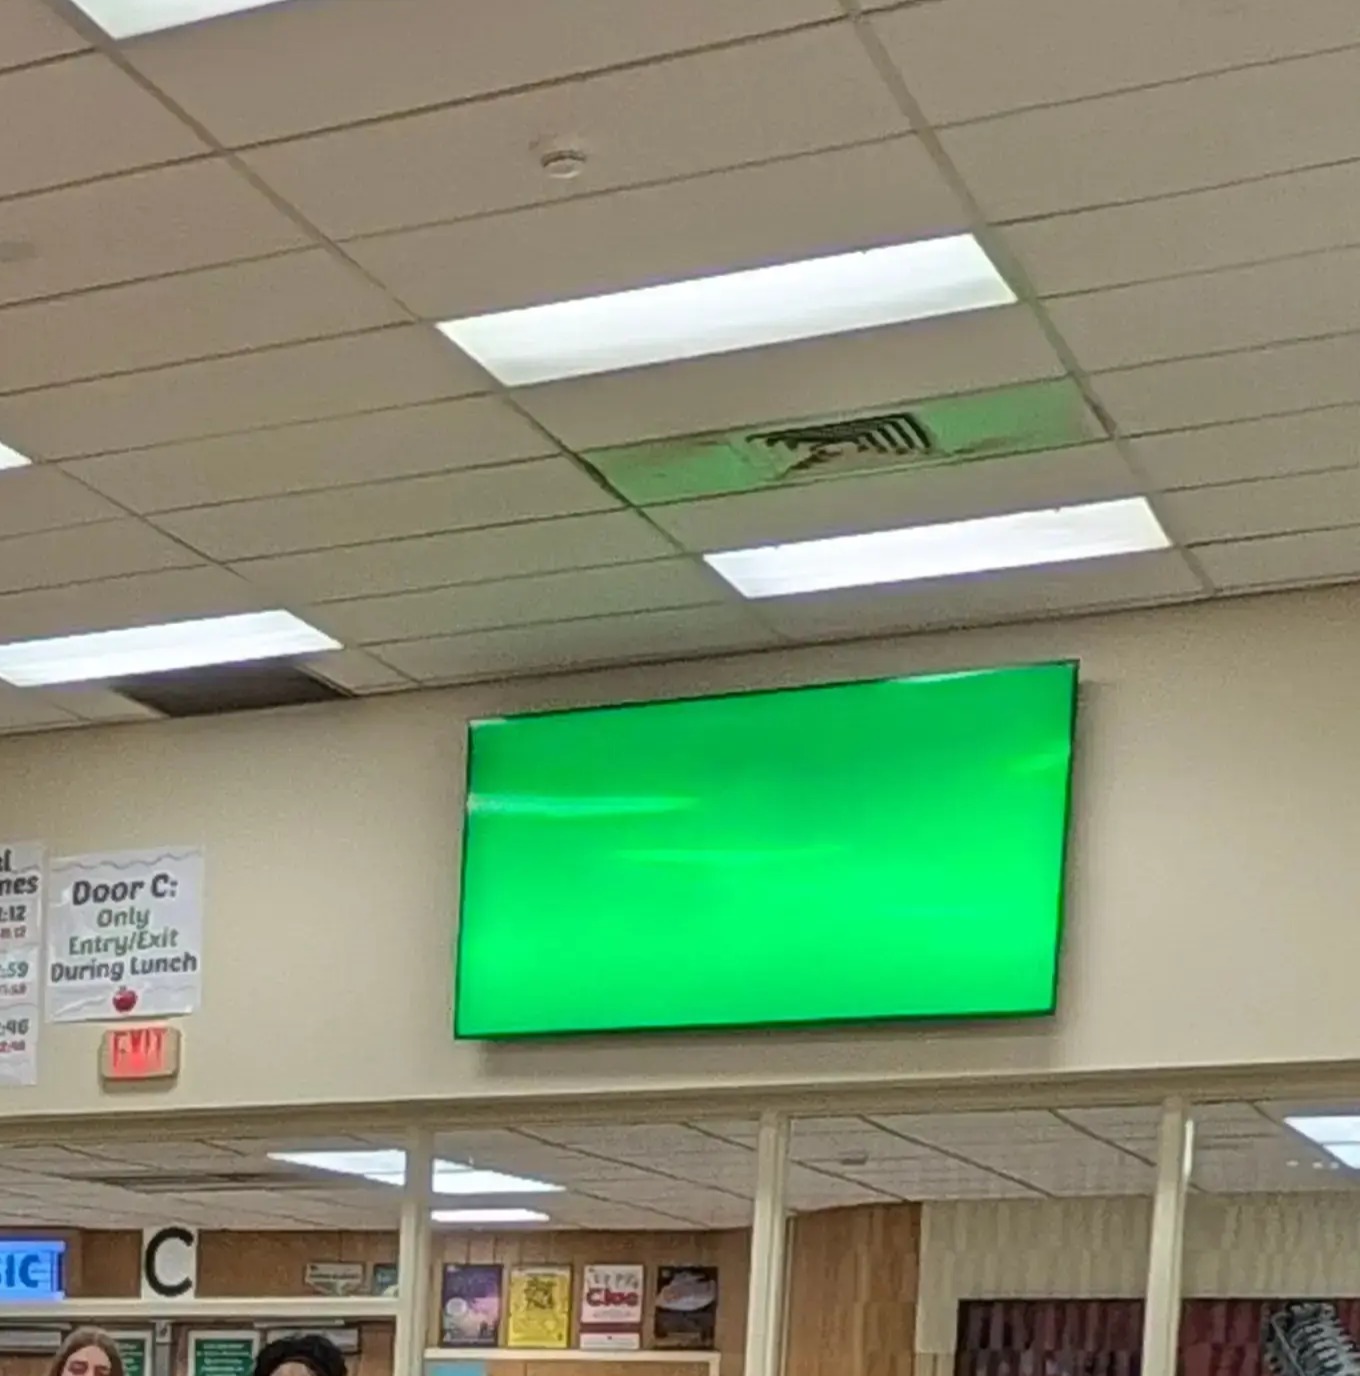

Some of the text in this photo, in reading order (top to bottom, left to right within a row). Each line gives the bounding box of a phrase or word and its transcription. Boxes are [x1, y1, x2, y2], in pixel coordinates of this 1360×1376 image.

[72, 873, 178, 906] Door C:
[97, 906, 151, 930] Only
[69, 927, 178, 956] Entry/Exit
[51, 952, 197, 982] During Lunch
[145, 1227, 194, 1297] C
